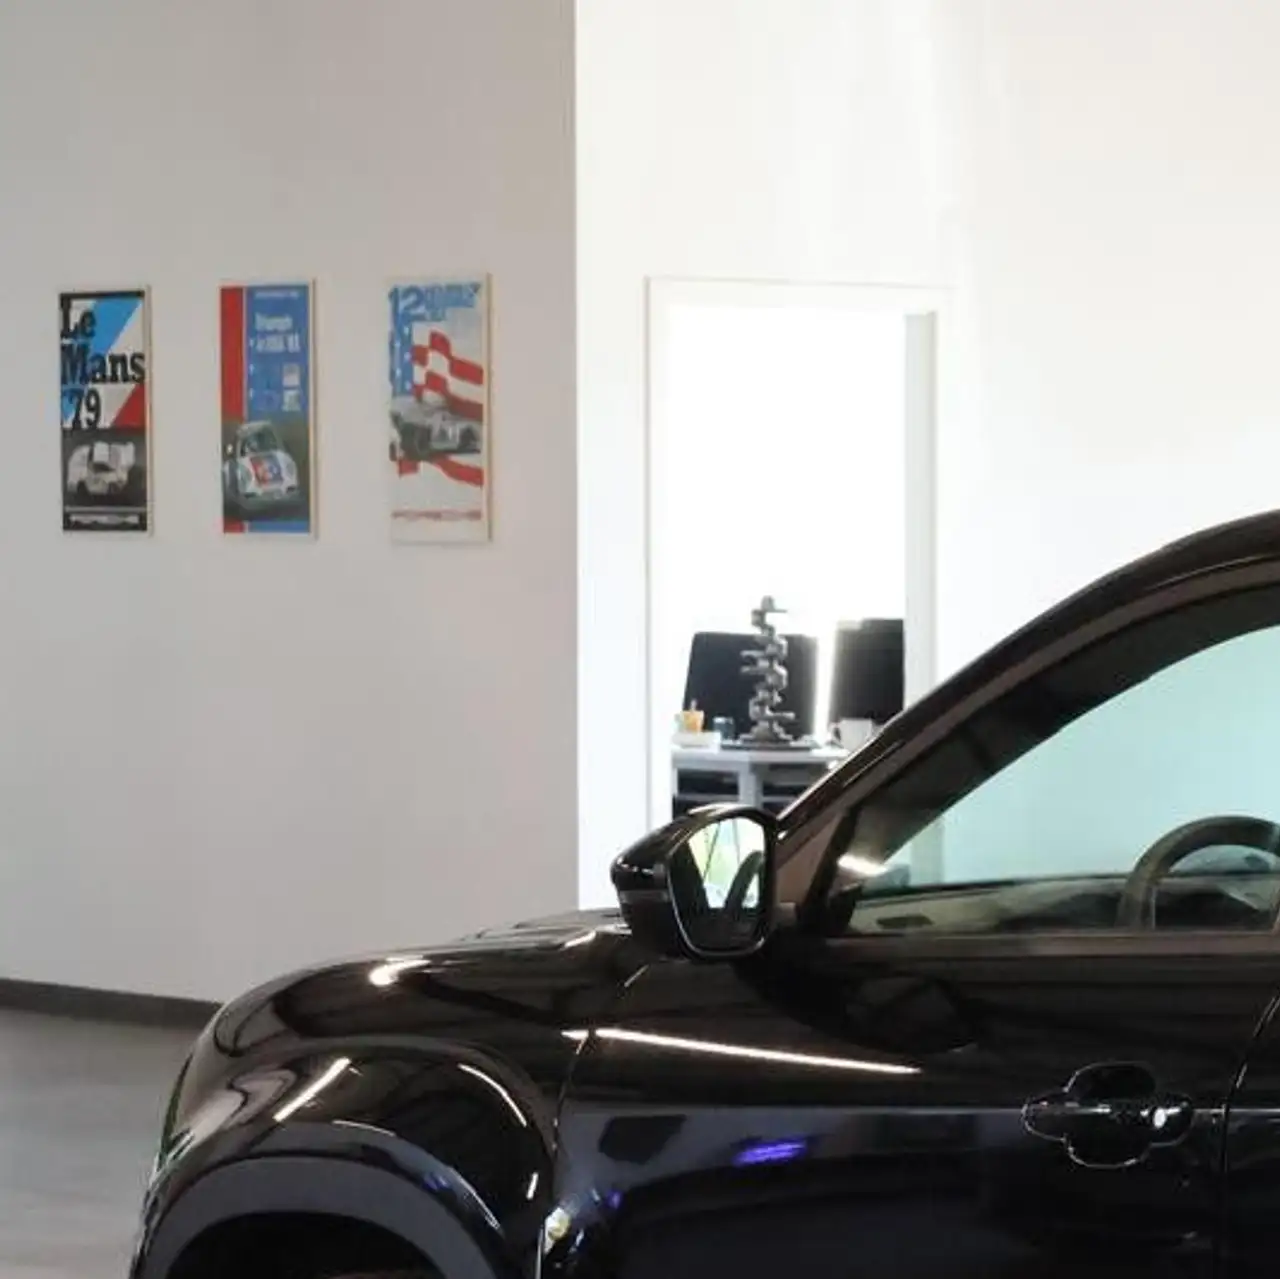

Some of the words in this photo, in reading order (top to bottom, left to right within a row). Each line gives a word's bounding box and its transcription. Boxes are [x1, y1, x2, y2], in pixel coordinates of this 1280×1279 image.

[60, 297, 96, 338] Le
[60, 344, 146, 386] Mans
[64, 387, 102, 430] 79
